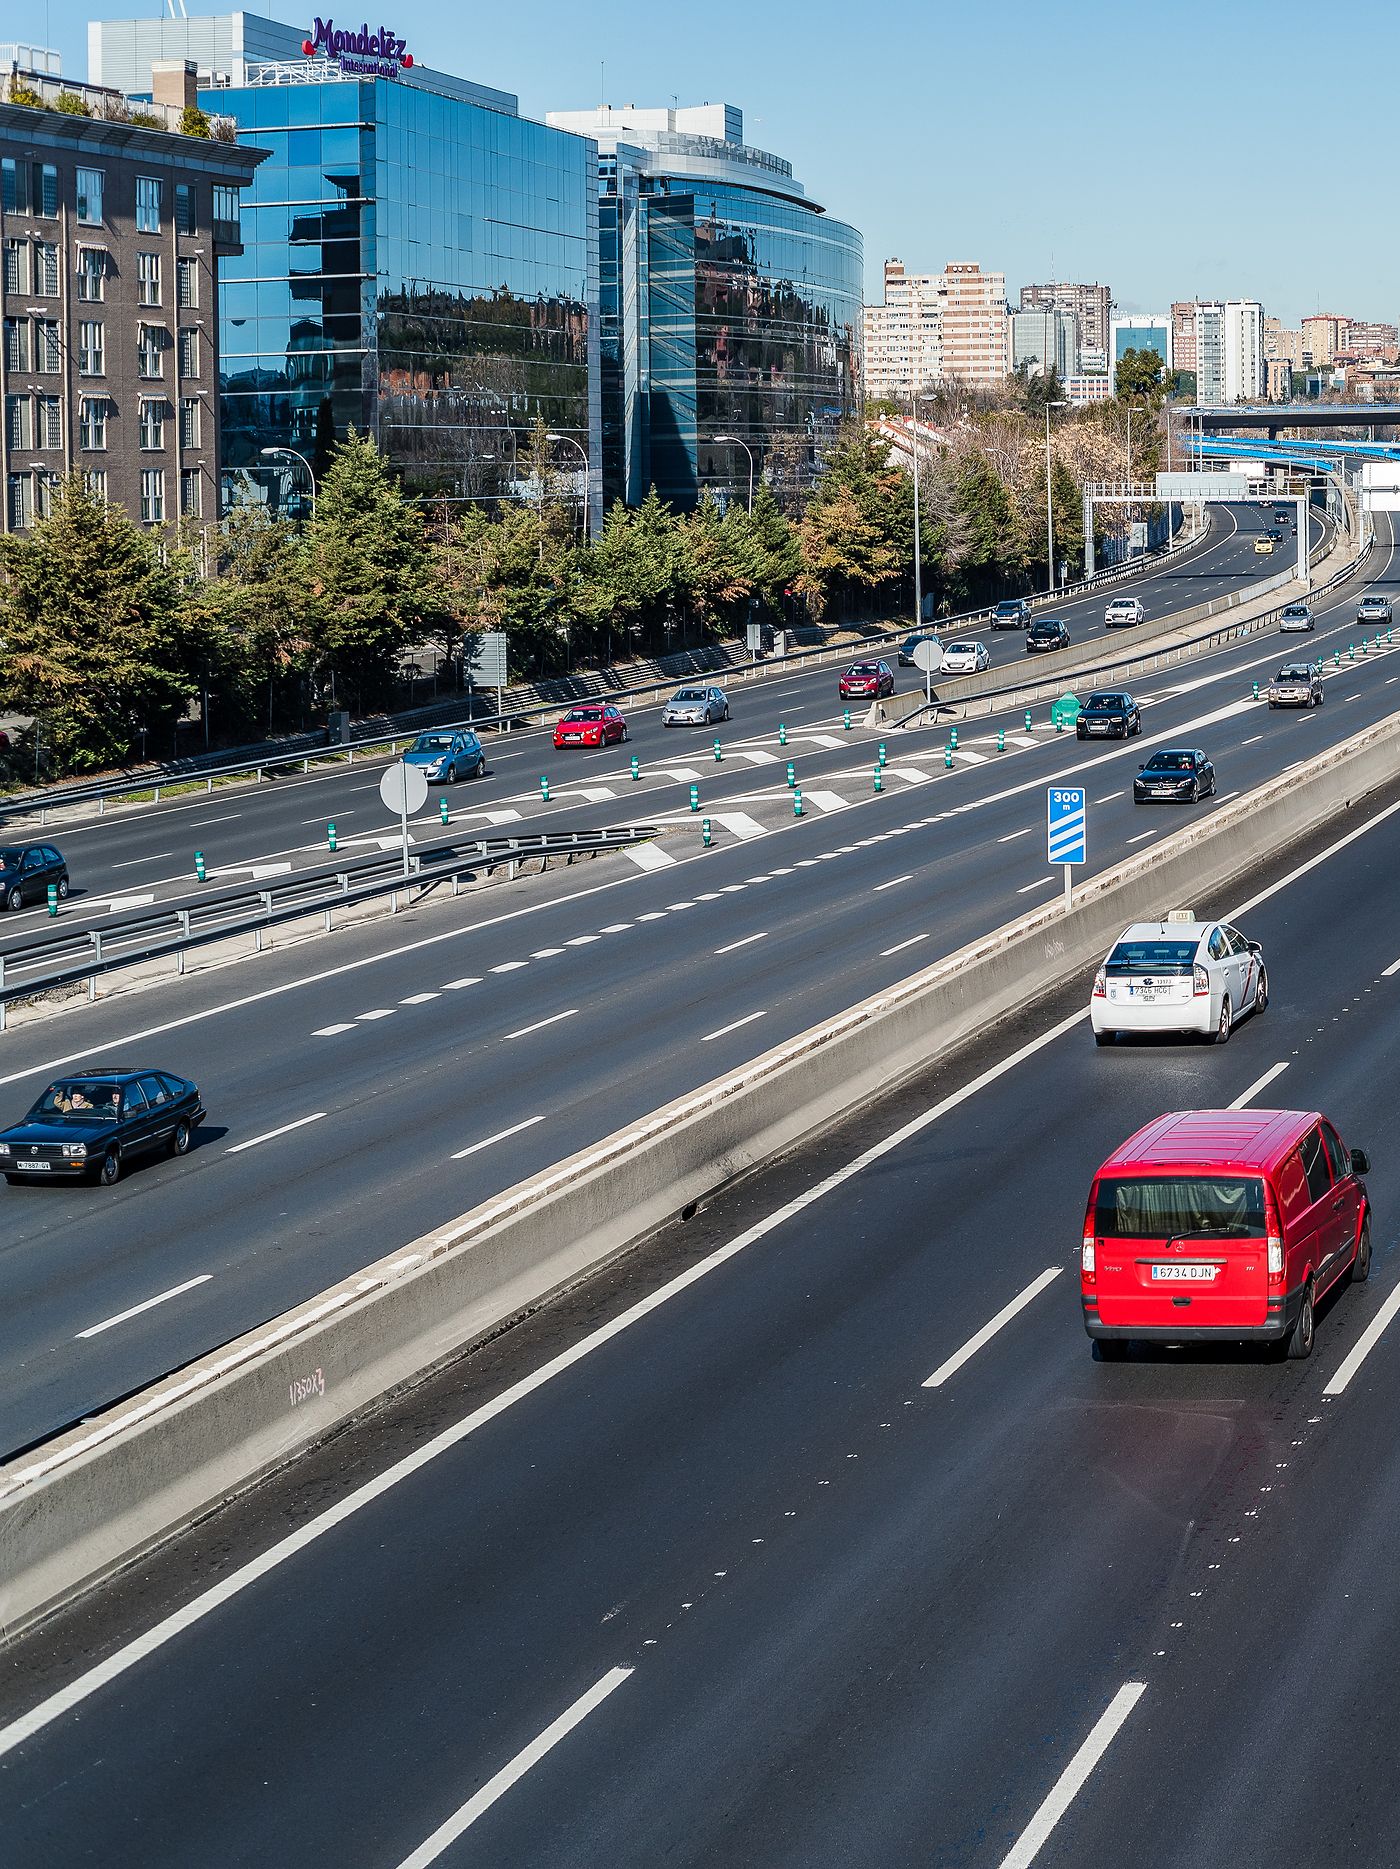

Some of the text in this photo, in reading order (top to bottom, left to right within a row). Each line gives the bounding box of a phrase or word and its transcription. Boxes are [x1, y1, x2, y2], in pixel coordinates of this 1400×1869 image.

[1053, 791, 1080, 803] 300
[1160, 1267, 1212, 1278] 6734 DJN
